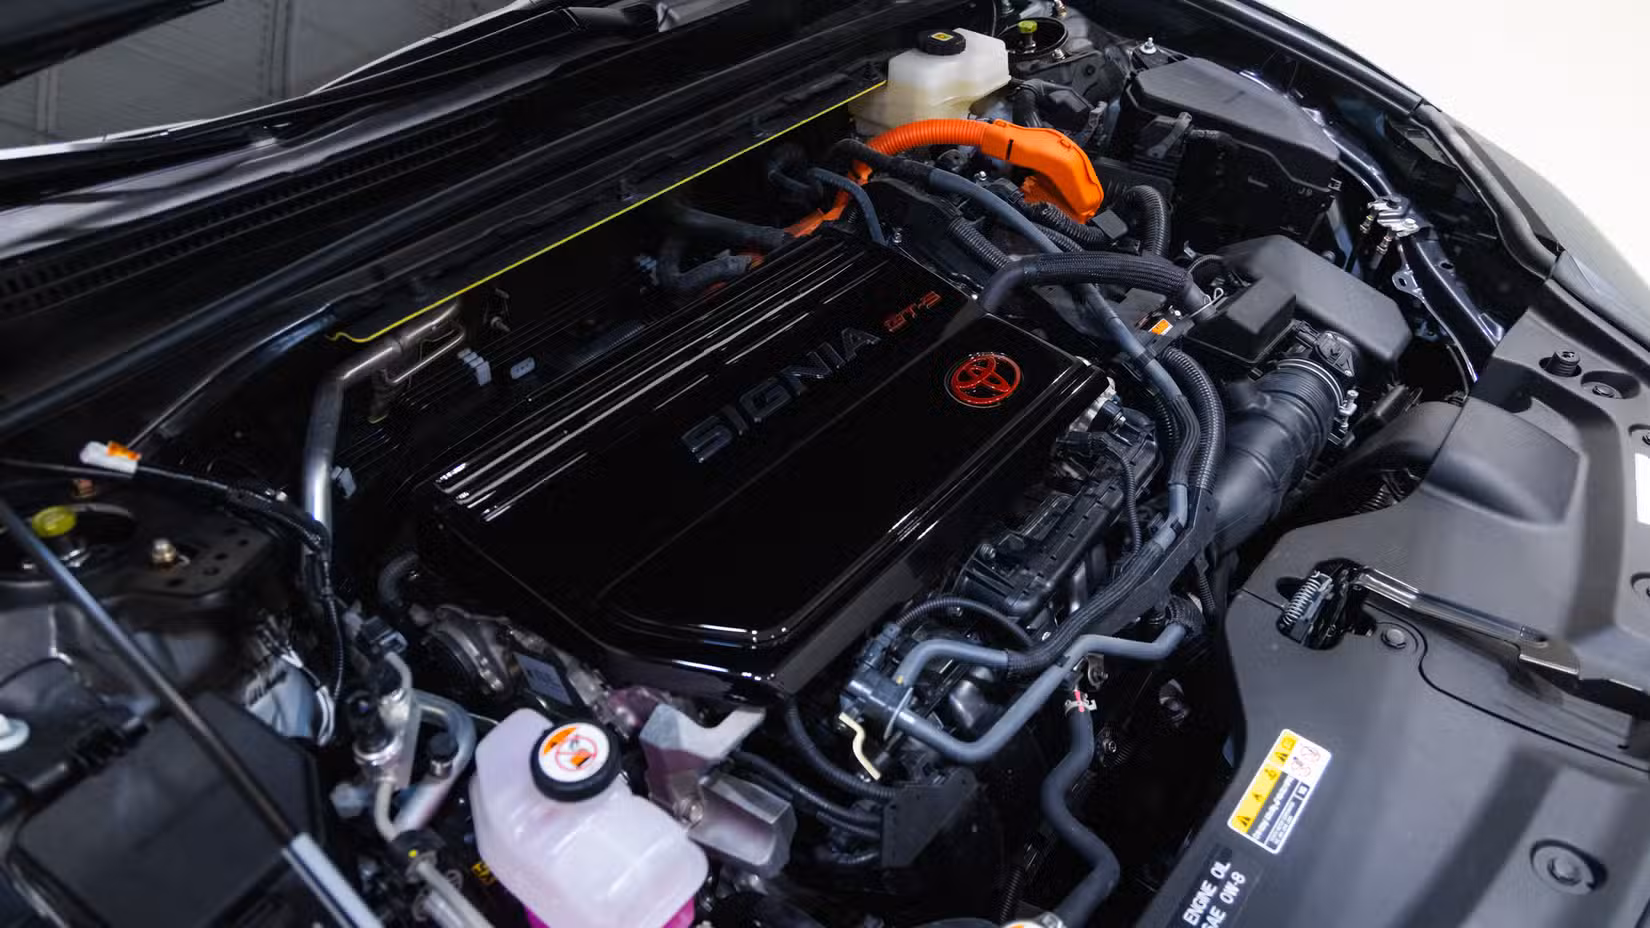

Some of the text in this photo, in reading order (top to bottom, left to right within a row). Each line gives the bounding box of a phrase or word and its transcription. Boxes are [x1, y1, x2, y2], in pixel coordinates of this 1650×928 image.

[681, 327, 881, 463] SIGNIA
[1182, 861, 1231, 926] ENGINE OIL
